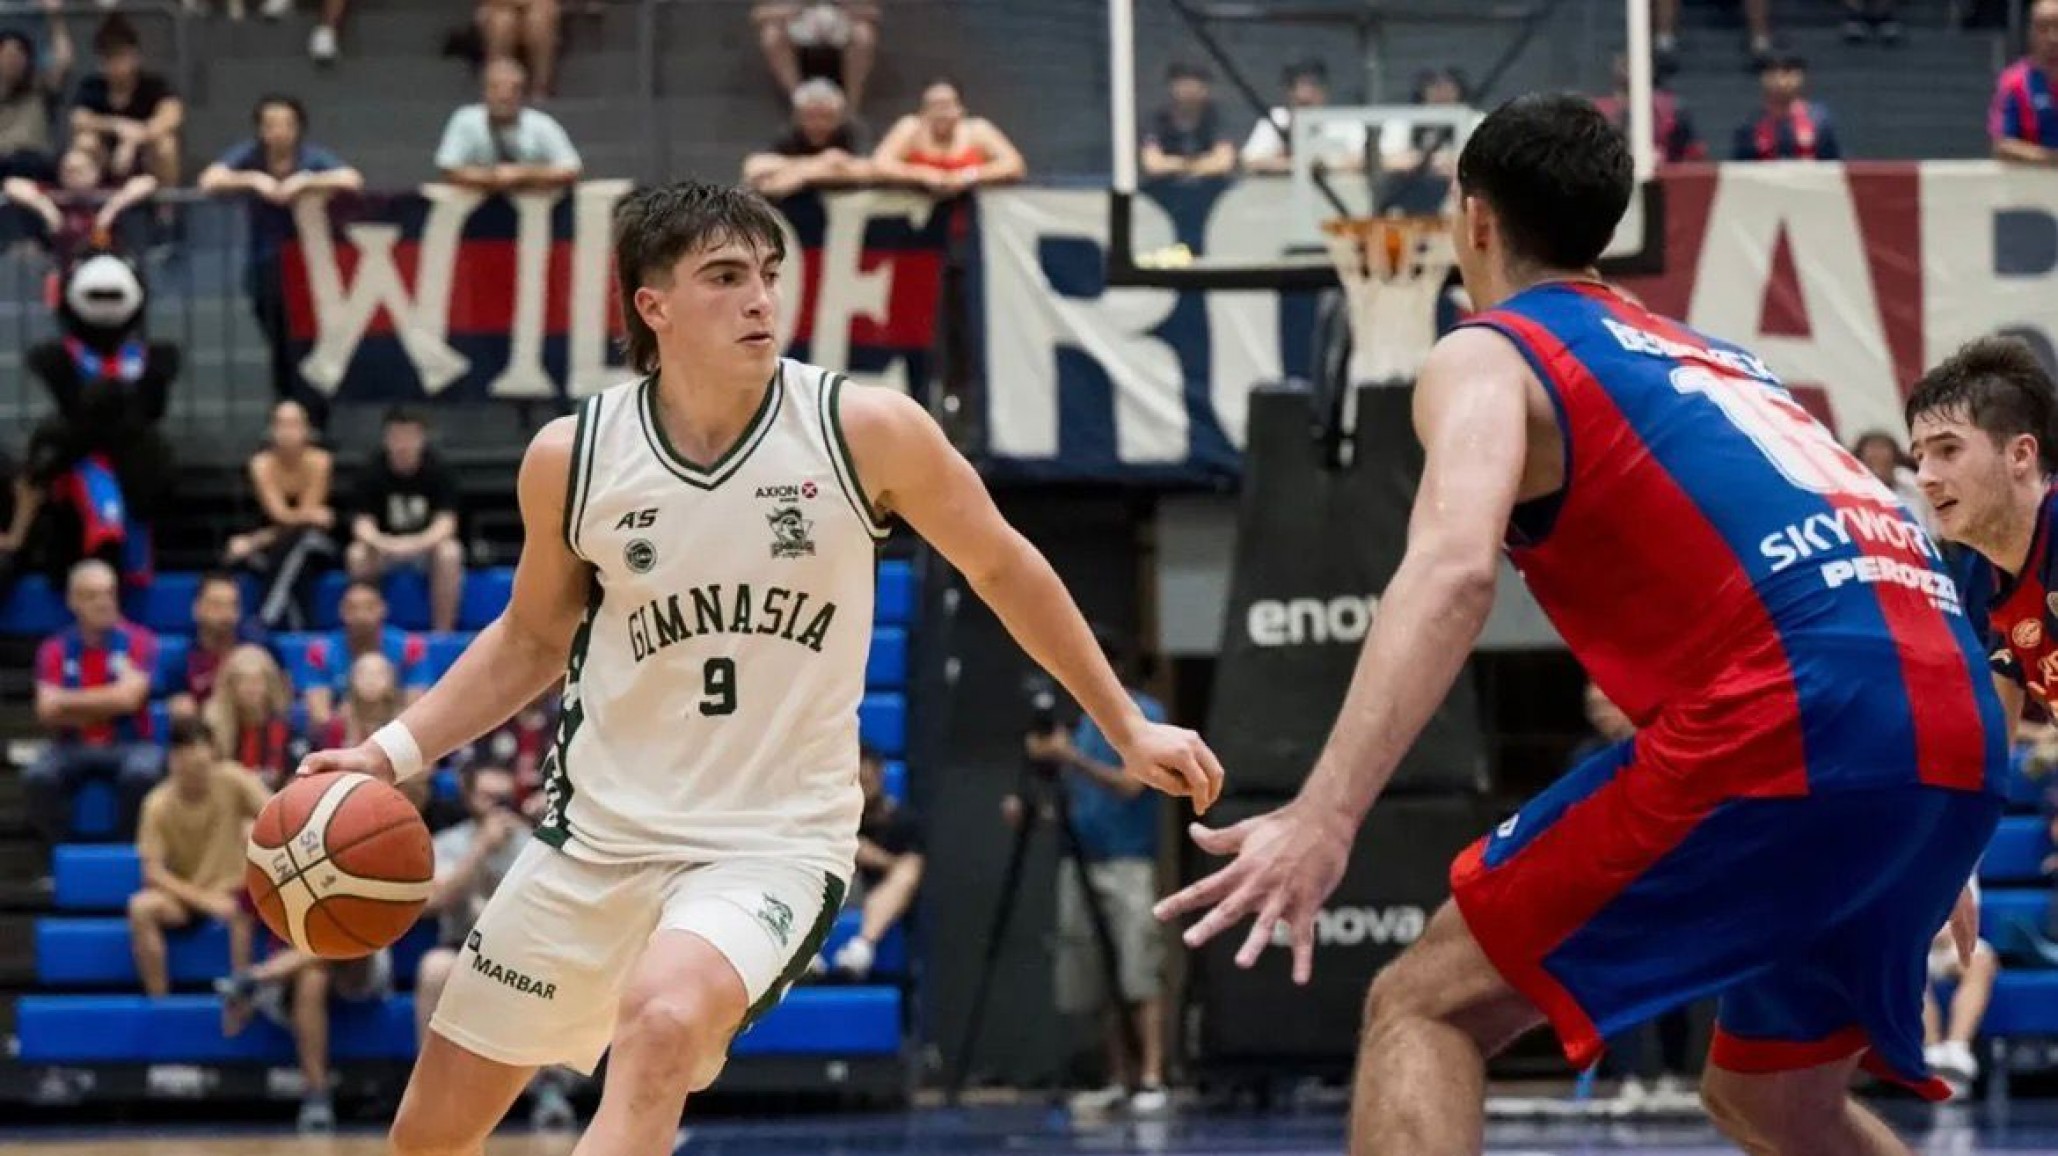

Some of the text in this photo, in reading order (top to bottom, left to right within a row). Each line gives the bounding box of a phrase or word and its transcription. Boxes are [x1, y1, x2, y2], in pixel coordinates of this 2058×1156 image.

[755, 484, 799, 499] AXION
[614, 507, 660, 531] AS
[627, 583, 837, 663] GIMNASIA
[1248, 595, 1381, 646] eno
[699, 656, 737, 717] 9
[471, 953, 557, 1001] MARBAR
